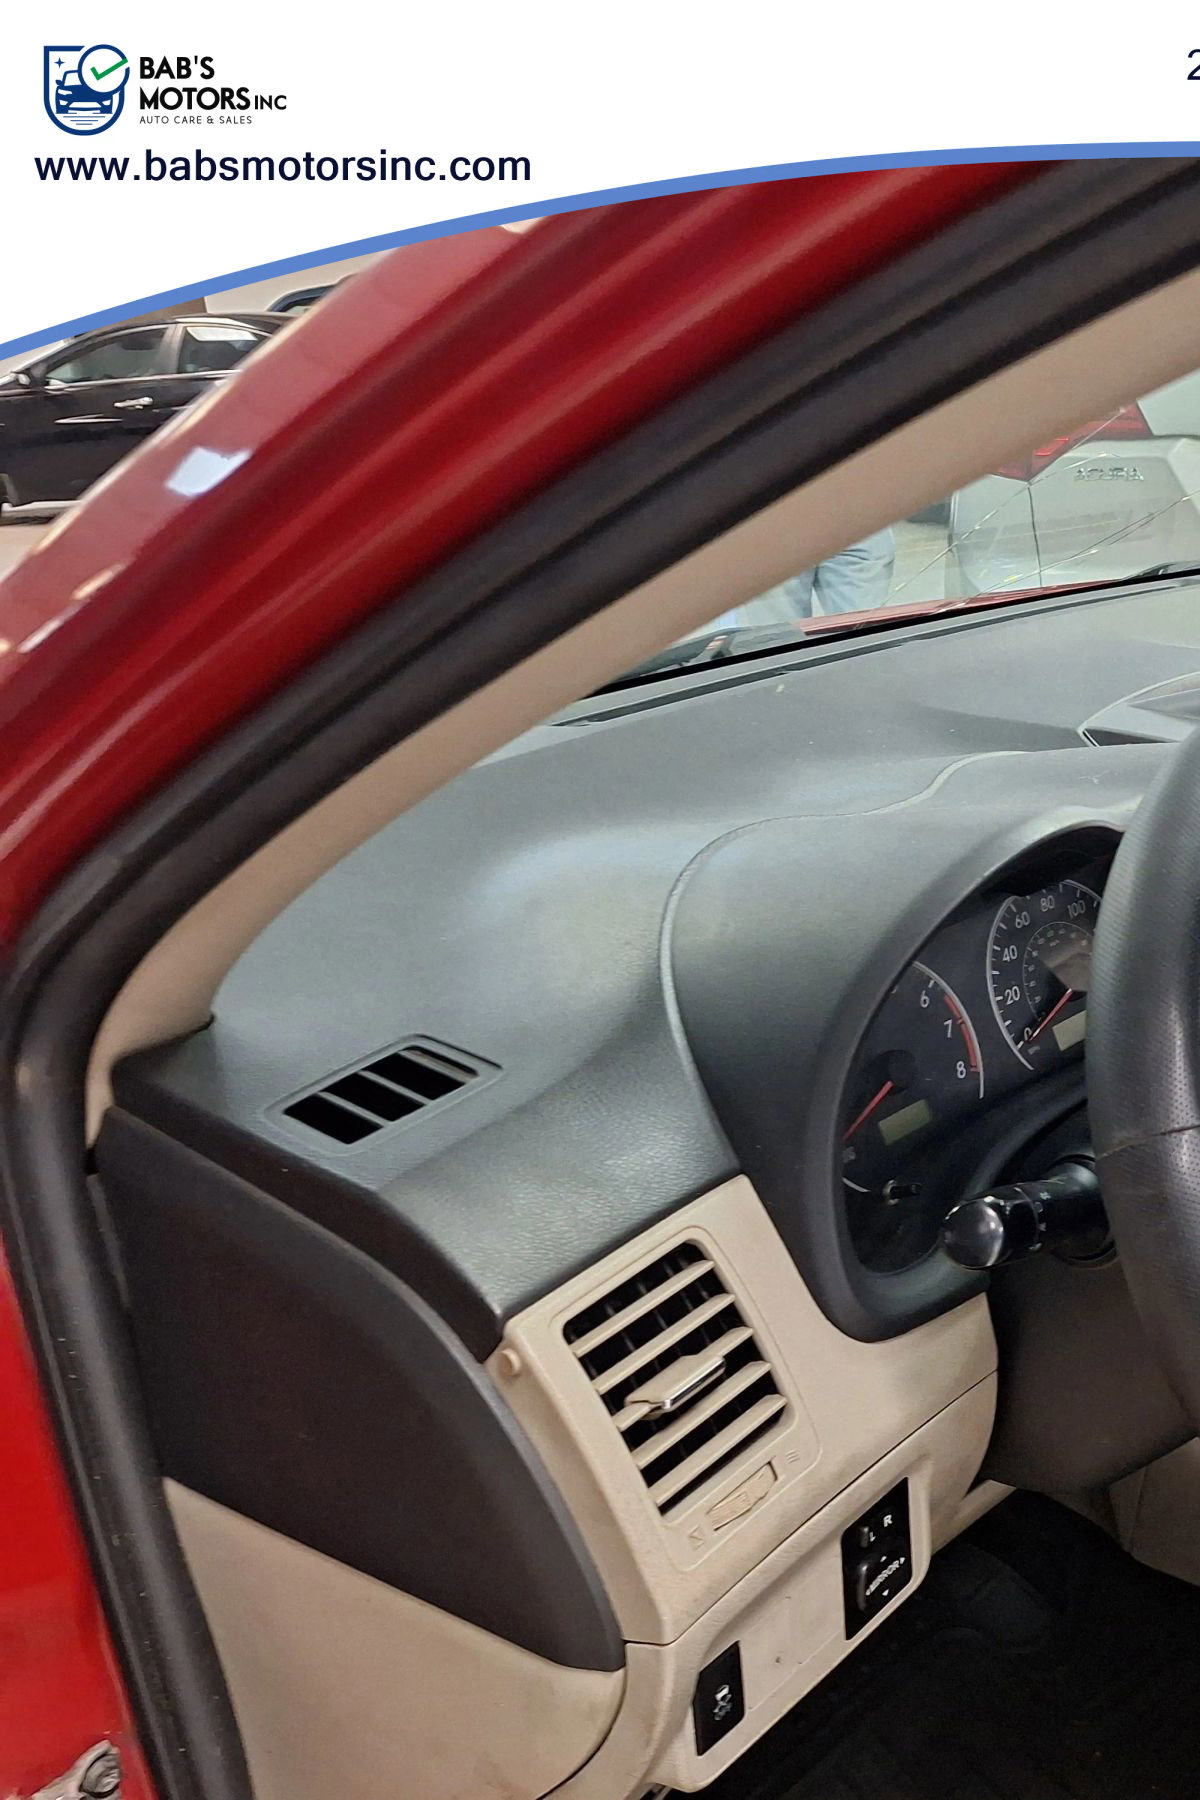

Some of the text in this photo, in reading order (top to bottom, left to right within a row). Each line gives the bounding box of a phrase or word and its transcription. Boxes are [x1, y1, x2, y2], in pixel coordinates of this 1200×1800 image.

[1040, 895, 1055, 912] 80
[1067, 900, 1086, 918] 100
[1015, 911, 1030, 928] 60
[1002, 945, 1018, 962] 40
[920, 990, 930, 1008] 6
[1004, 985, 1020, 1005] 20
[943, 1018, 953, 1038] 7
[956, 1060, 967, 1079] 8
[883, 1514, 893, 1527] R
